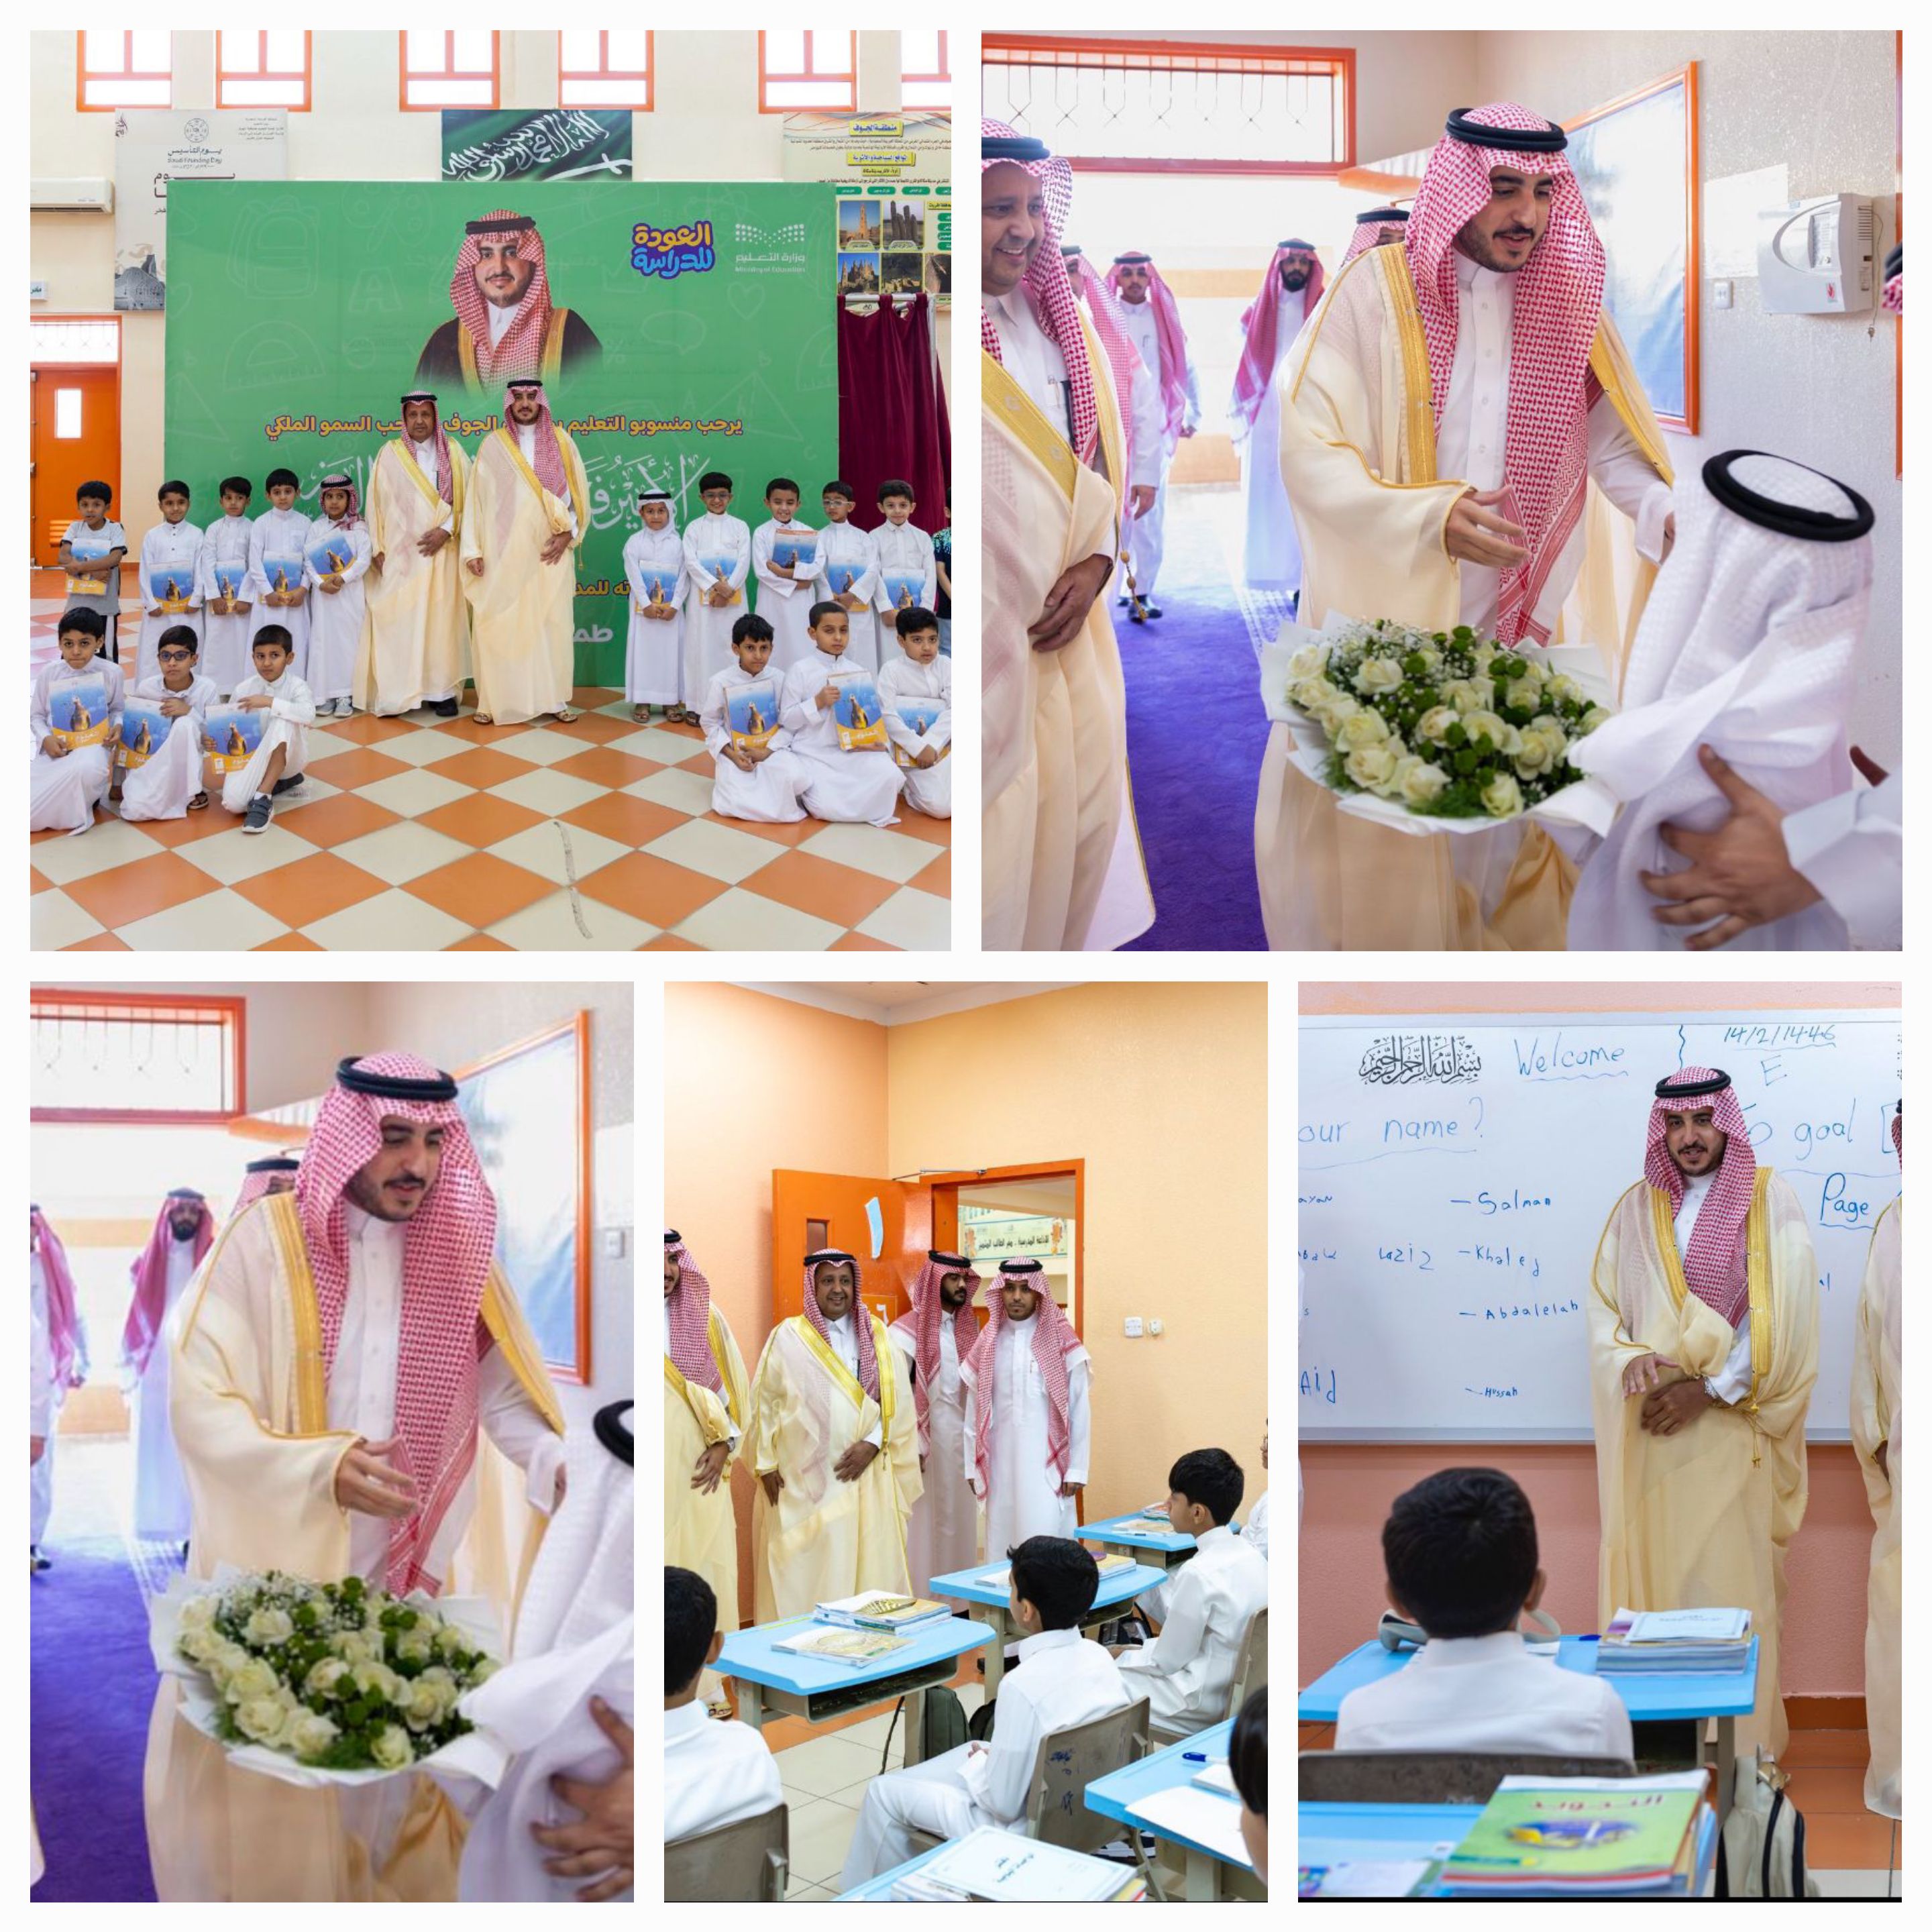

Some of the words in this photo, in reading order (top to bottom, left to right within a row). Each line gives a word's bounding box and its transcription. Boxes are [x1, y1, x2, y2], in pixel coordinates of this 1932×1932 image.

[635, 223, 711, 252] العودة
[633, 247, 713, 278] للدراسة
[736, 252, 779, 263] التعليم
[781, 252, 805, 263] وزارة
[265, 415, 315, 440] الملكي
[318, 416, 372, 436] السمو
[443, 413, 498, 435] الجوف
[568, 415, 626, 437] التعليم
[629, 417, 692, 436] منسوبو
[696, 417, 743, 436] يرحب
[1514, 1031, 1625, 1075] Welcome
[1760, 1055, 1788, 1086] E
[1298, 1121, 1351, 1142] our
[1794, 1097, 1856, 1161] goal
[1478, 1189, 1552, 1215] Salman
[1820, 1173, 1869, 1223] Page
